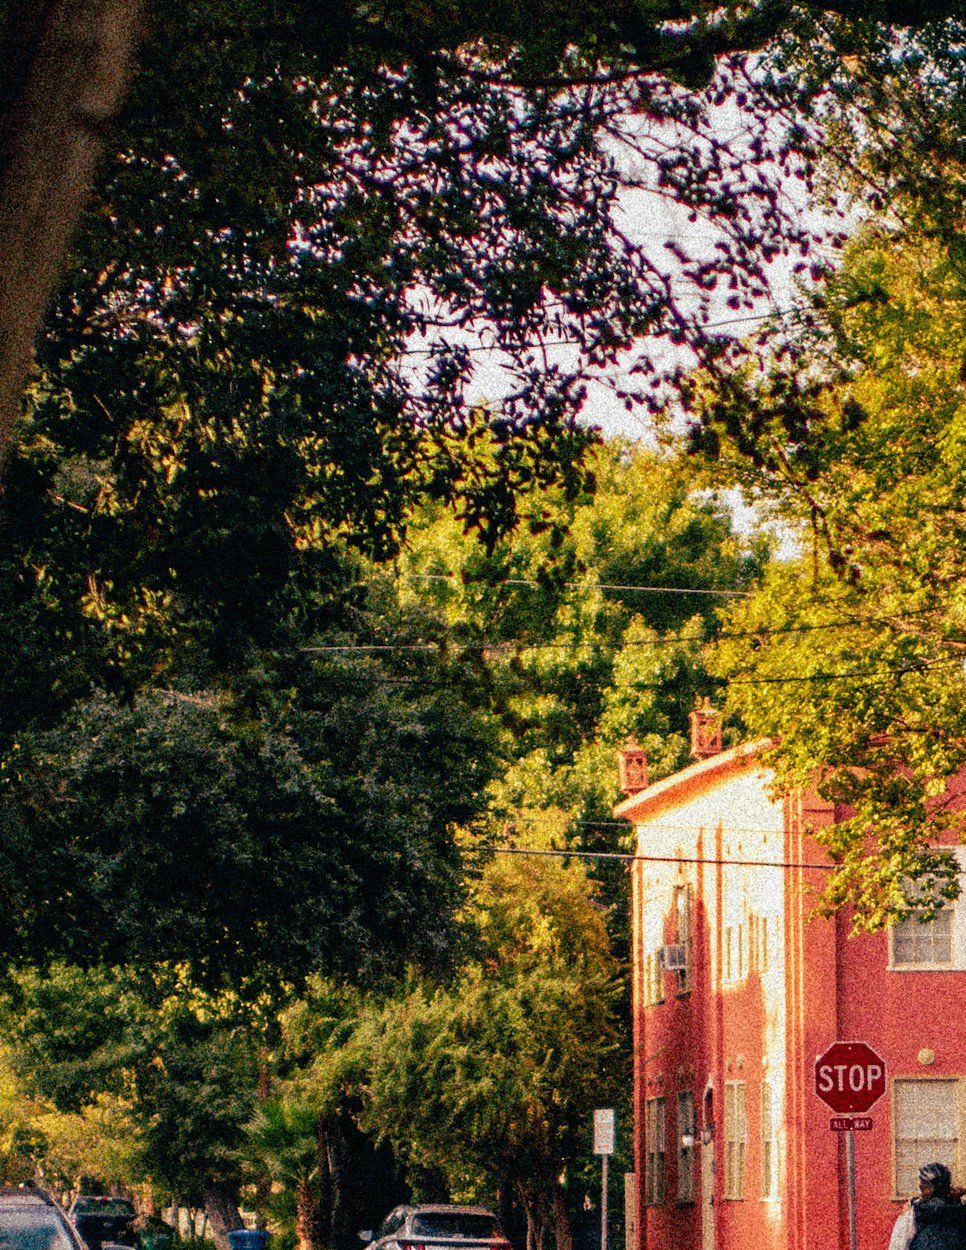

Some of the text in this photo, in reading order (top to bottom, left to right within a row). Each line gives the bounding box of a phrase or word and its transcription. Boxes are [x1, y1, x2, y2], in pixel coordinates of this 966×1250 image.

[819, 1065, 881, 1092] STOP
[833, 1119, 870, 1129] ALL WAY
